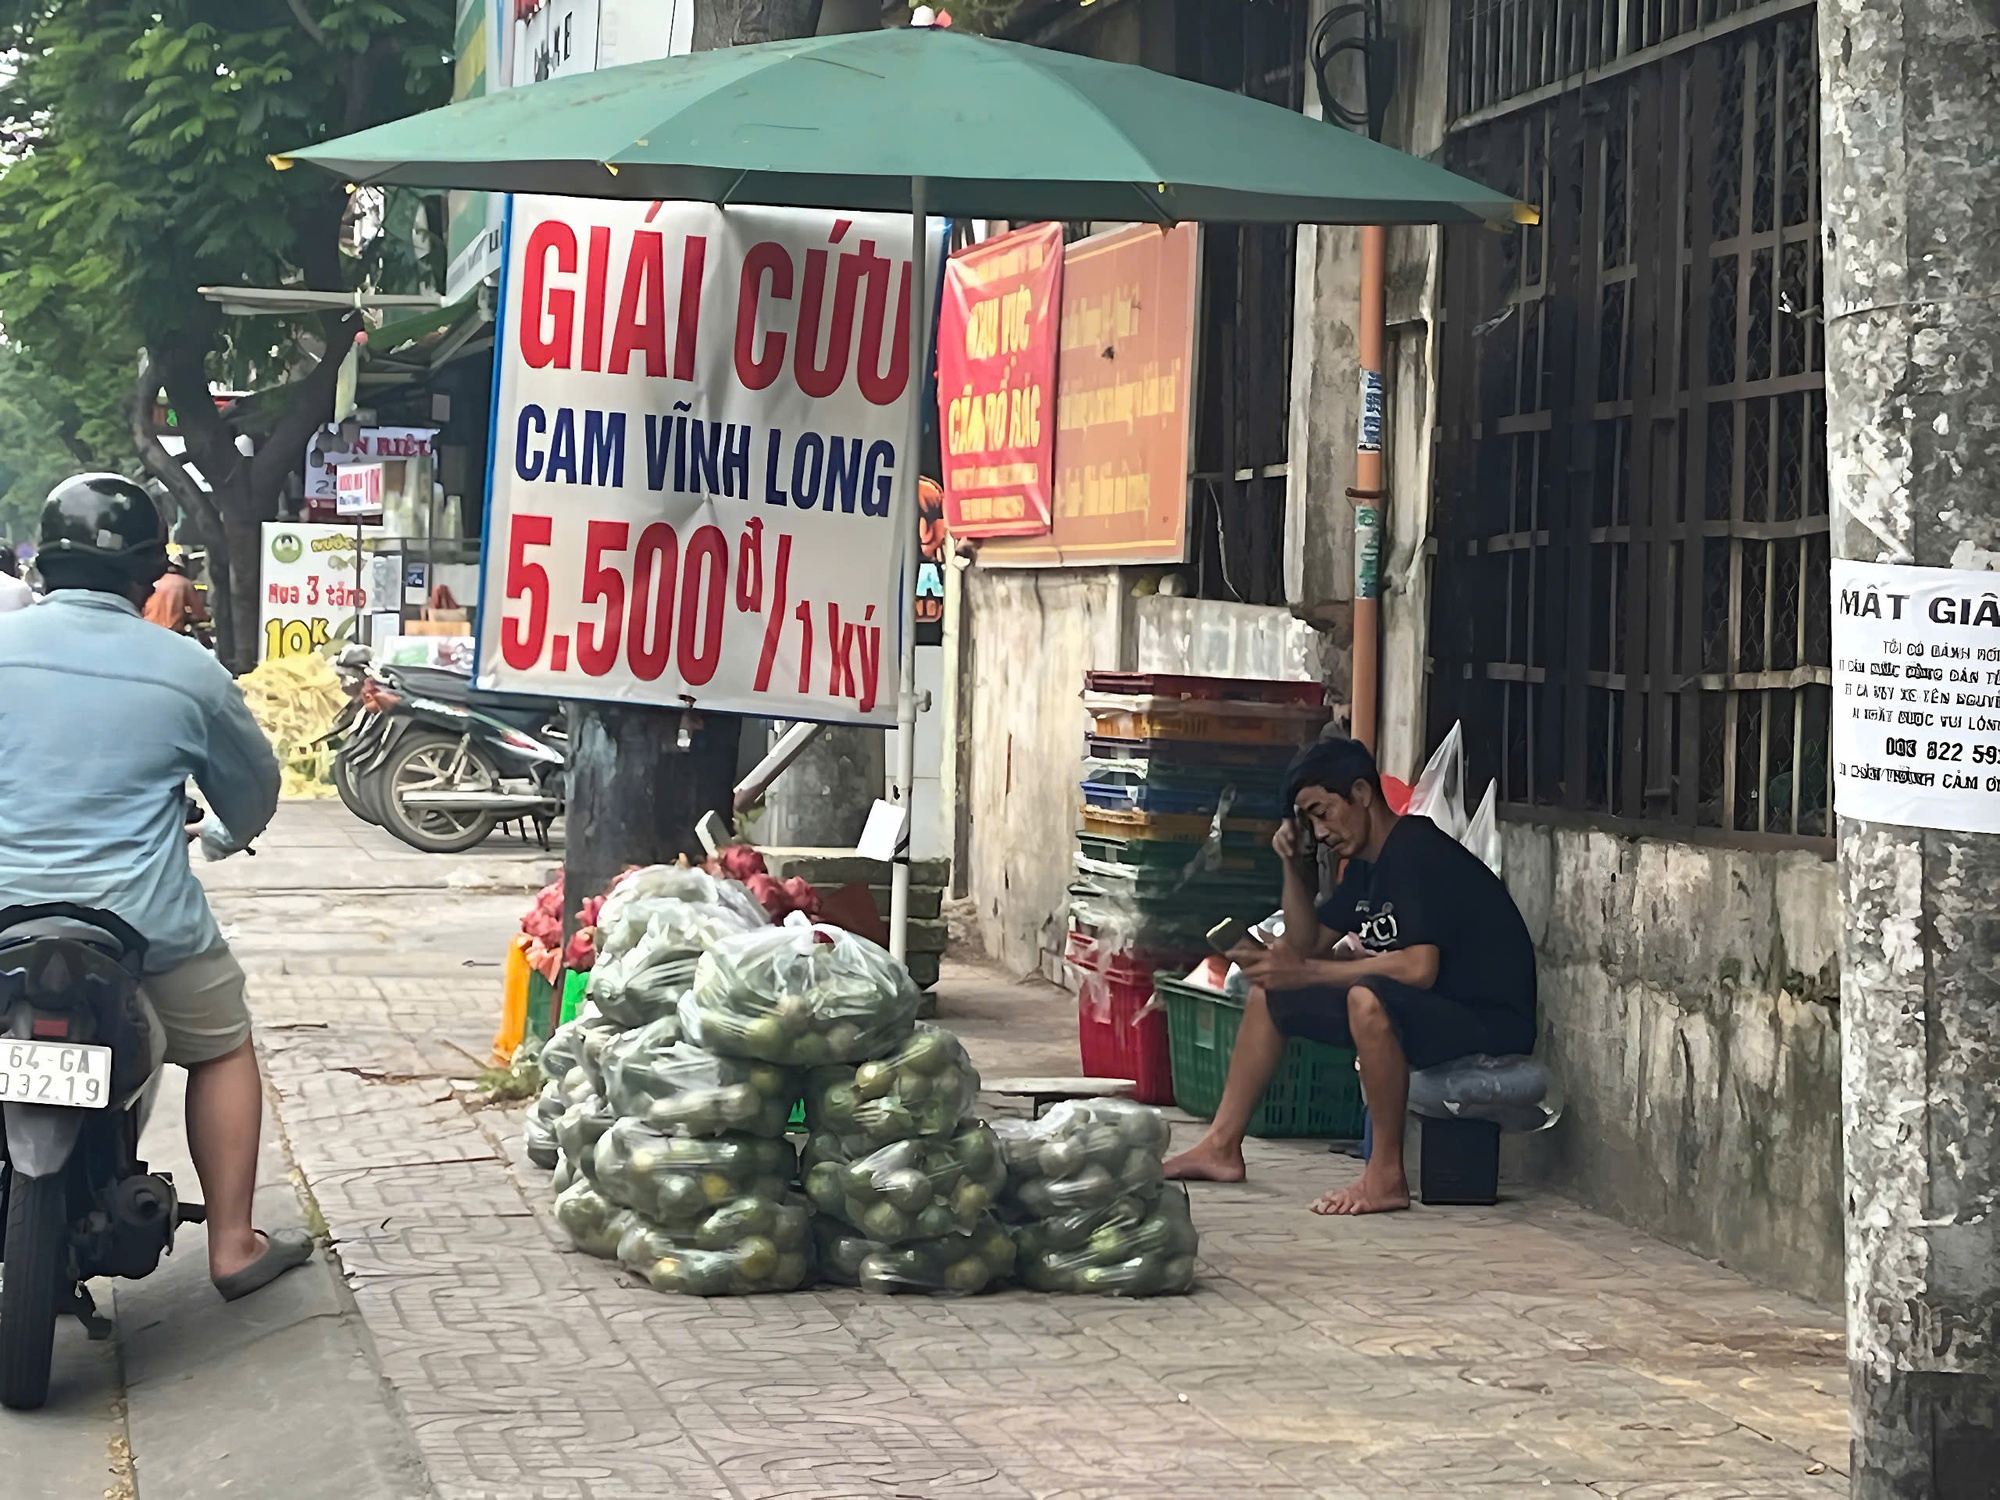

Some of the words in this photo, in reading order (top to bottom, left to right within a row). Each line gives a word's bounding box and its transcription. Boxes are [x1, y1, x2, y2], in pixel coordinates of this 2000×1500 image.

[514, 403, 627, 488] CAM
[645, 401, 751, 500] VĨNH
[765, 428, 896, 518] LONG
[307, 575, 320, 605] 3
[1840, 581, 1911, 620] MẤT
[265, 617, 333, 662] 10K
